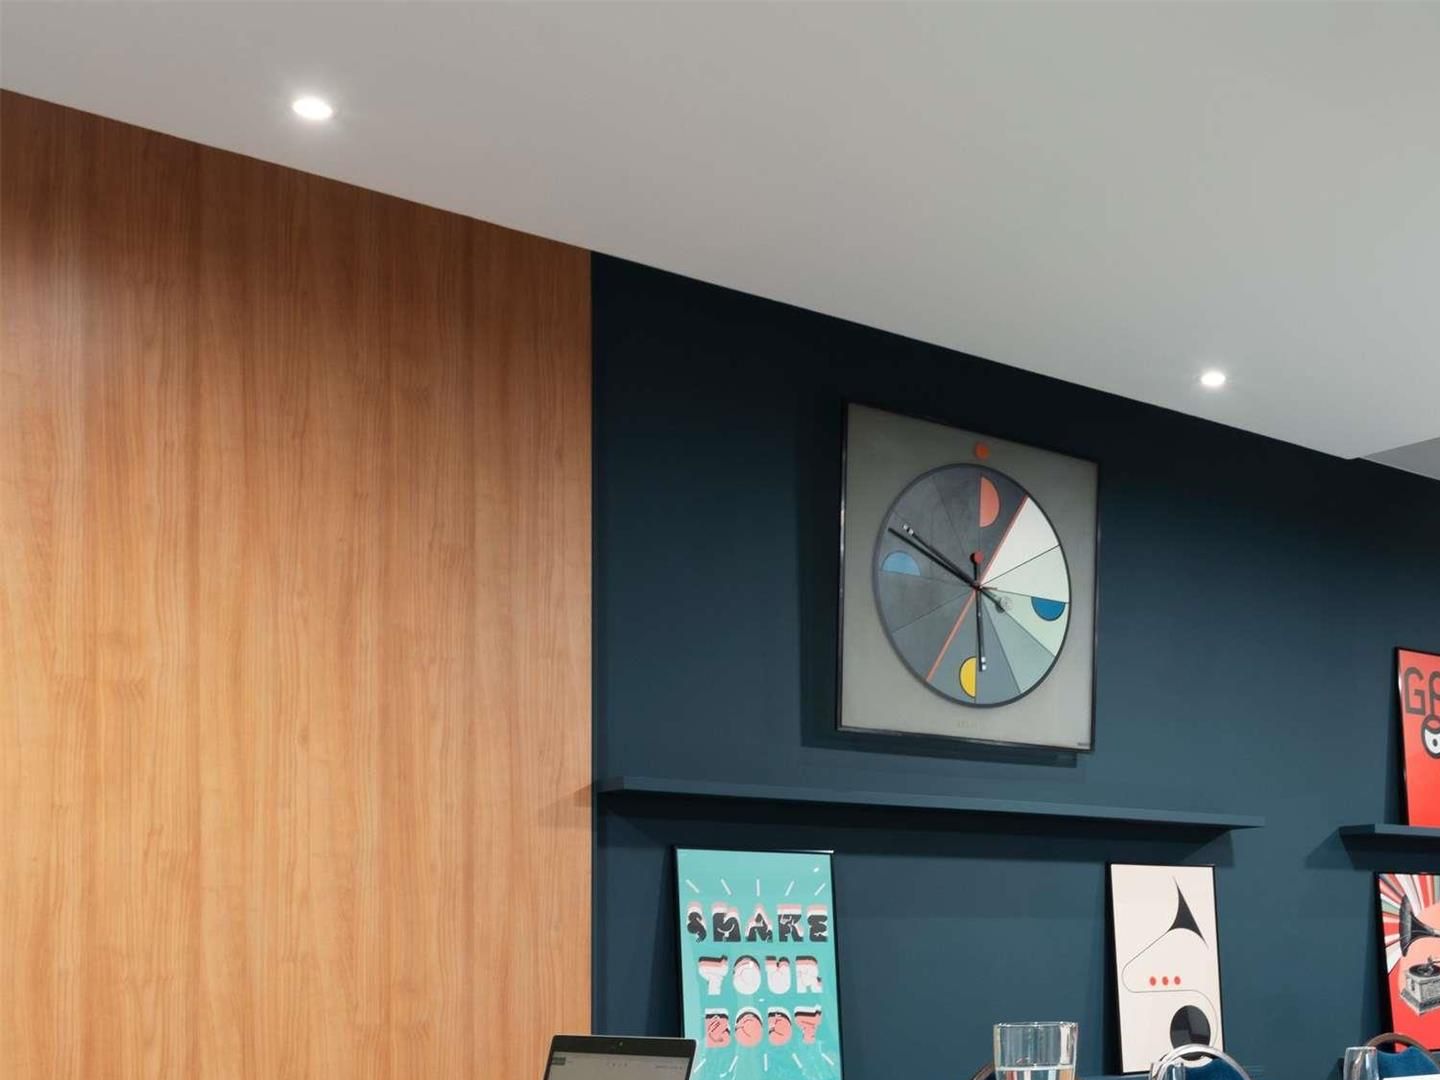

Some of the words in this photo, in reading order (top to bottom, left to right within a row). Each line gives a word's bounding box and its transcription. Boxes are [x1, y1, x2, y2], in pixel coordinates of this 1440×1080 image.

[687, 901, 829, 943] SHAKE
[697, 955, 823, 995] YOUR
[704, 1005, 823, 1049] BODY
